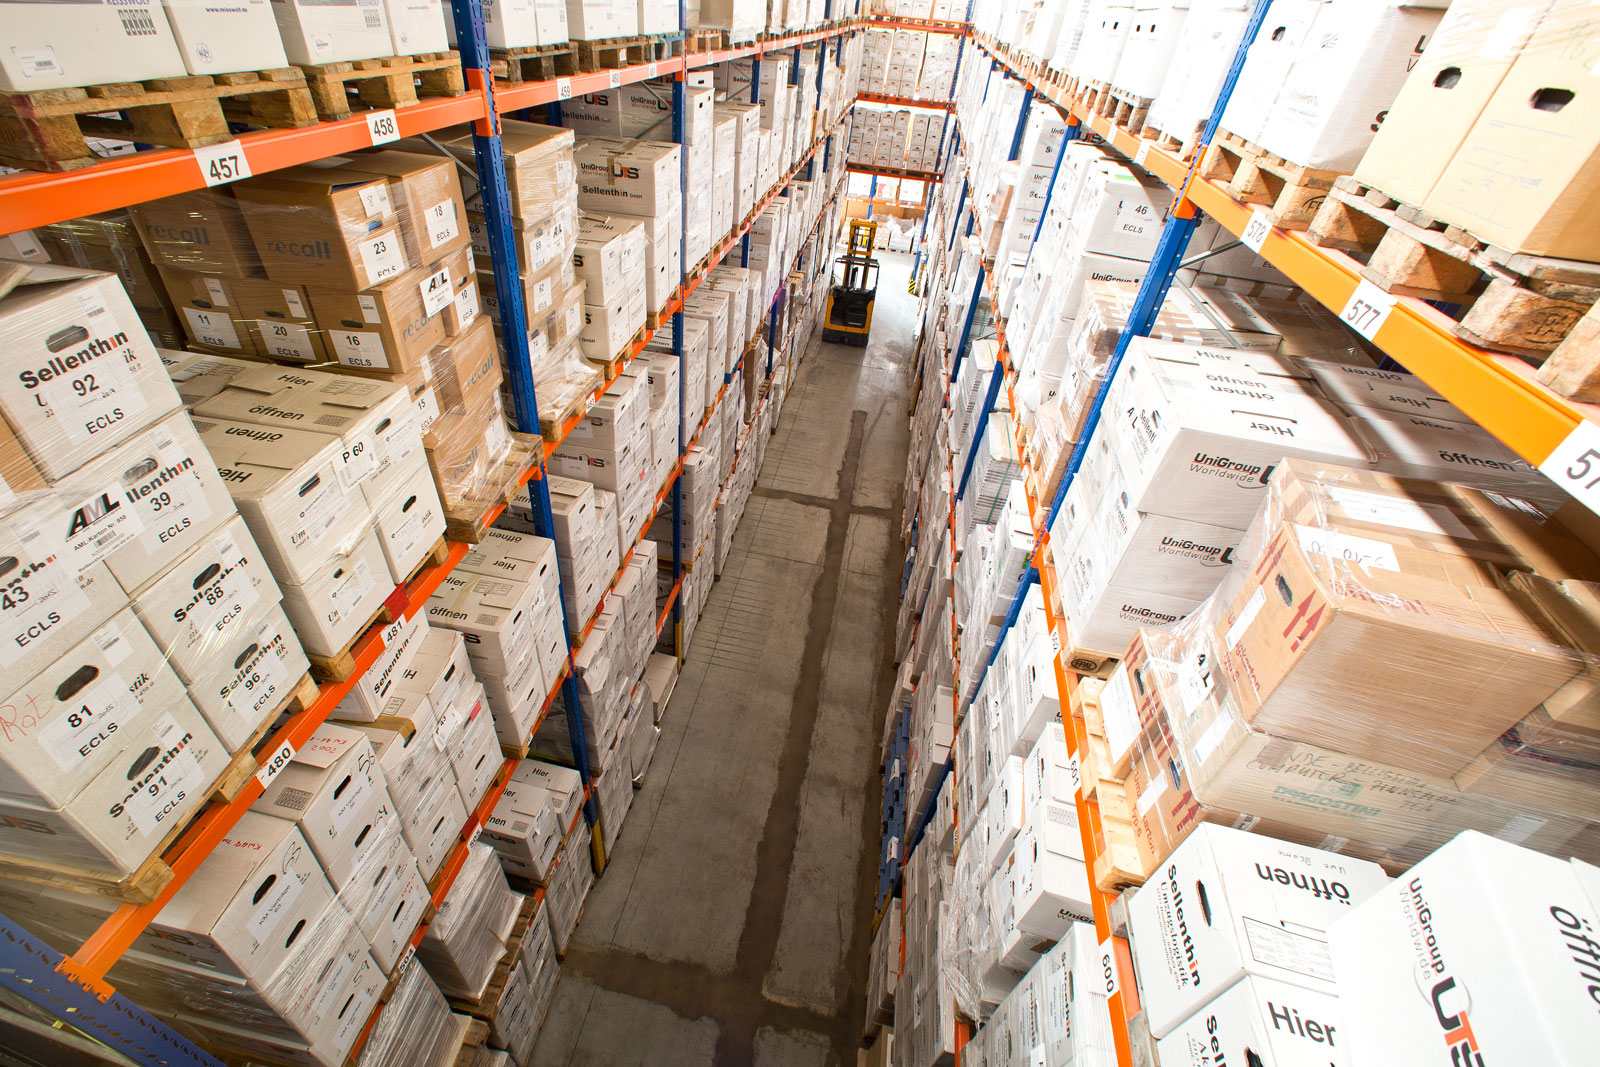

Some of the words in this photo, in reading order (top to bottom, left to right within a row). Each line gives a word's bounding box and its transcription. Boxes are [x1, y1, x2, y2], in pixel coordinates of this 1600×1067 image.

[560, 86, 571, 98] 459
[631, 95, 657, 105] UniGroup
[373, 117, 394, 137] 458
[208, 155, 241, 181] 457
[611, 163, 640, 179] UTS
[582, 185, 628, 198] Sellenthin
[434, 205, 443, 218] 18
[1135, 204, 1148, 215] 46
[146, 222, 210, 247] recall
[436, 228, 451, 242] ECLS
[1122, 223, 1144, 235] ECLS
[1246, 219, 1268, 245] 578
[266, 239, 332, 261] recall
[373, 241, 387, 255] 23
[377, 265, 397, 279] ECLS
[198, 313, 210, 327] 11
[1346, 298, 1381, 332] 577
[203, 336, 225, 346] ECLS
[273, 325, 288, 337] 20
[345, 335, 361, 347] 16
[19, 331, 129, 390] Sellenthin
[276, 347, 301, 358] ECLS
[348, 357, 373, 367] ECLS
[1196, 350, 1233, 361] Hier
[276, 374, 314, 387] Hier
[1205, 373, 1268, 389] öffnen
[1340, 366, 1404, 382] öffnen
[71, 373, 101, 398] 92
[1210, 384, 1275, 402] öffnen
[248, 404, 305, 421] öffnen
[417, 398, 426, 410] 15
[1388, 394, 1431, 409] Hier
[85, 407, 125, 435] ECLS
[1250, 420, 1295, 437] Hier
[224, 425, 284, 443] öffnen
[343, 451, 350, 464] P
[352, 441, 364, 457] 60
[1193, 452, 1262, 475] UniGroup
[1438, 450, 1517, 473] öffnen
[125, 457, 195, 504] llenthin
[1189, 462, 1255, 484] Worldwide
[149, 491, 172, 513] 39
[67, 492, 121, 538] AML
[73, 527, 108, 551] AML-Karton
[158, 517, 192, 545] ECLS
[488, 531, 523, 544] öffnen
[1157, 544, 1217, 563] Worldwide
[1161, 536, 1222, 555] UniGroup
[492, 560, 517, 571] Hier
[2, 586, 30, 611] 43
[206, 586, 225, 606] 88
[215, 603, 242, 632] ECLS
[429, 606, 468, 621] öffnen
[1121, 603, 1177, 623] UniGroup
[14, 611, 62, 648] ECLS
[386, 620, 403, 642] 481
[219, 633, 283, 699] Sellenthin
[373, 638, 409, 694] Sellenthin
[245, 671, 261, 691] 96
[252, 684, 277, 712] ECLS
[67, 704, 94, 729] 81
[78, 721, 119, 758] ECLS
[266, 746, 292, 778] 480
[531, 767, 550, 778] Hier
[1069, 759, 1080, 787] 601
[147, 775, 168, 798] 91
[154, 790, 187, 823] ECLS
[1254, 862, 1352, 906] öffnen
[1160, 881, 1189, 987] Umzugslogistik
[1167, 863, 1201, 987] Sellenthin
[1398, 885, 1433, 981] Worldwide
[1409, 876, 1446, 975] UniGroup
[399, 947, 415, 972] 504
[1101, 952, 1116, 994] 600
[1266, 1000, 1338, 1048] Hier
[1430, 974, 1488, 1067] UTS
